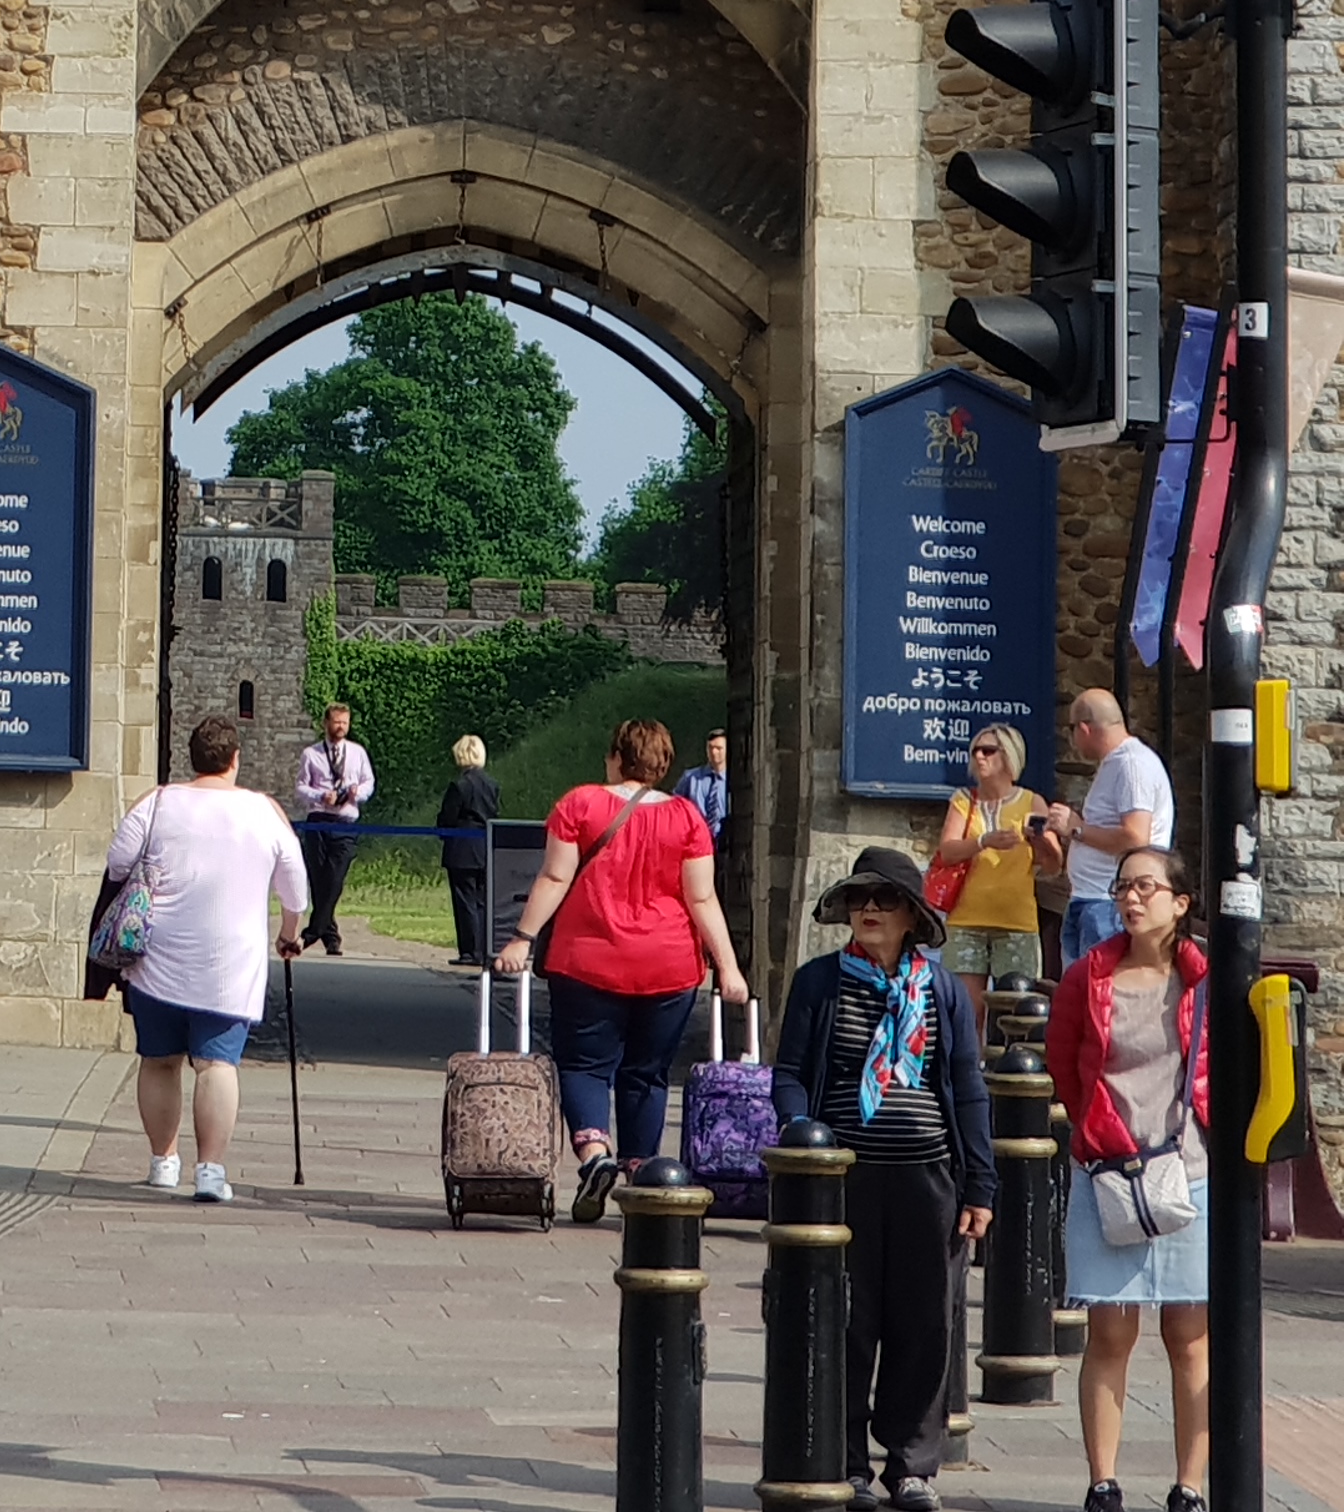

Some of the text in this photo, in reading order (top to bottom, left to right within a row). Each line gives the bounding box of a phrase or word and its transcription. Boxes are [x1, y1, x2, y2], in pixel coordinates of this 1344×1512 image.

[1245, 308, 1257, 331] 3
[911, 514, 986, 534] Welcome
[920, 540, 977, 559] Croeso
[908, 565, 989, 585] Bienvenue
[906, 590, 990, 611] Benvenuto
[899, 616, 997, 637] Willkommen
[905, 641, 990, 661] Bienvenido
[912, 667, 983, 689] ようこそ
[863, 693, 1031, 715] добро пожаловать
[923, 717, 970, 741] 欢迎
[904, 744, 969, 763] Bem-vin
